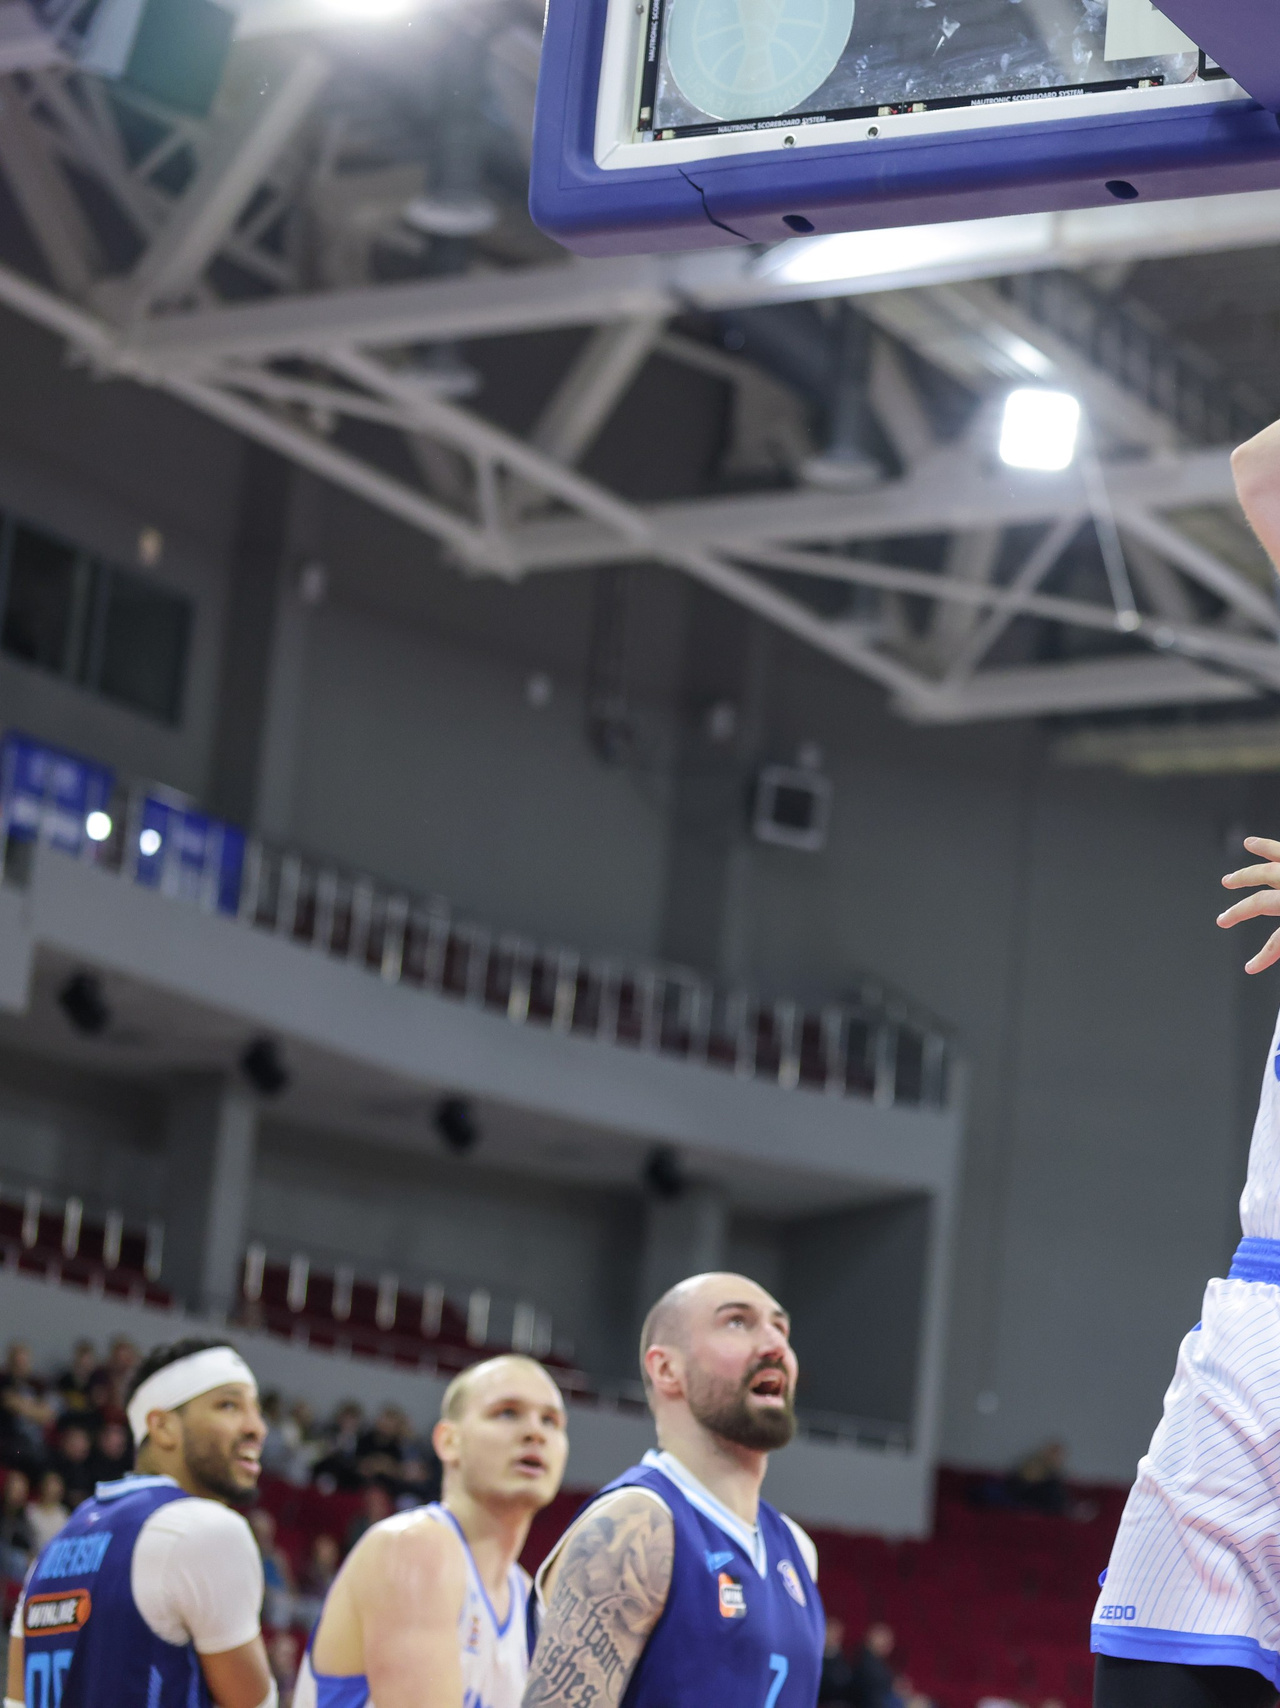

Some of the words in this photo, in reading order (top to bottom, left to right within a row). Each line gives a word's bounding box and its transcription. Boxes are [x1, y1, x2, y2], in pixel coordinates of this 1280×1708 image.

[648, 20, 658, 61] NAUTRONIC
[970, 96, 1011, 106] NAUTRONIC
[1012, 91, 1057, 101] SCOREBOARD
[1058, 88, 1084, 97] SYSTEM
[718, 123, 756, 134] NAUTRONIC
[757, 118, 800, 130] SCOREBOARD
[801, 115, 826, 126] SYSTEM
[1099, 1605, 1136, 1620] ZEDO
